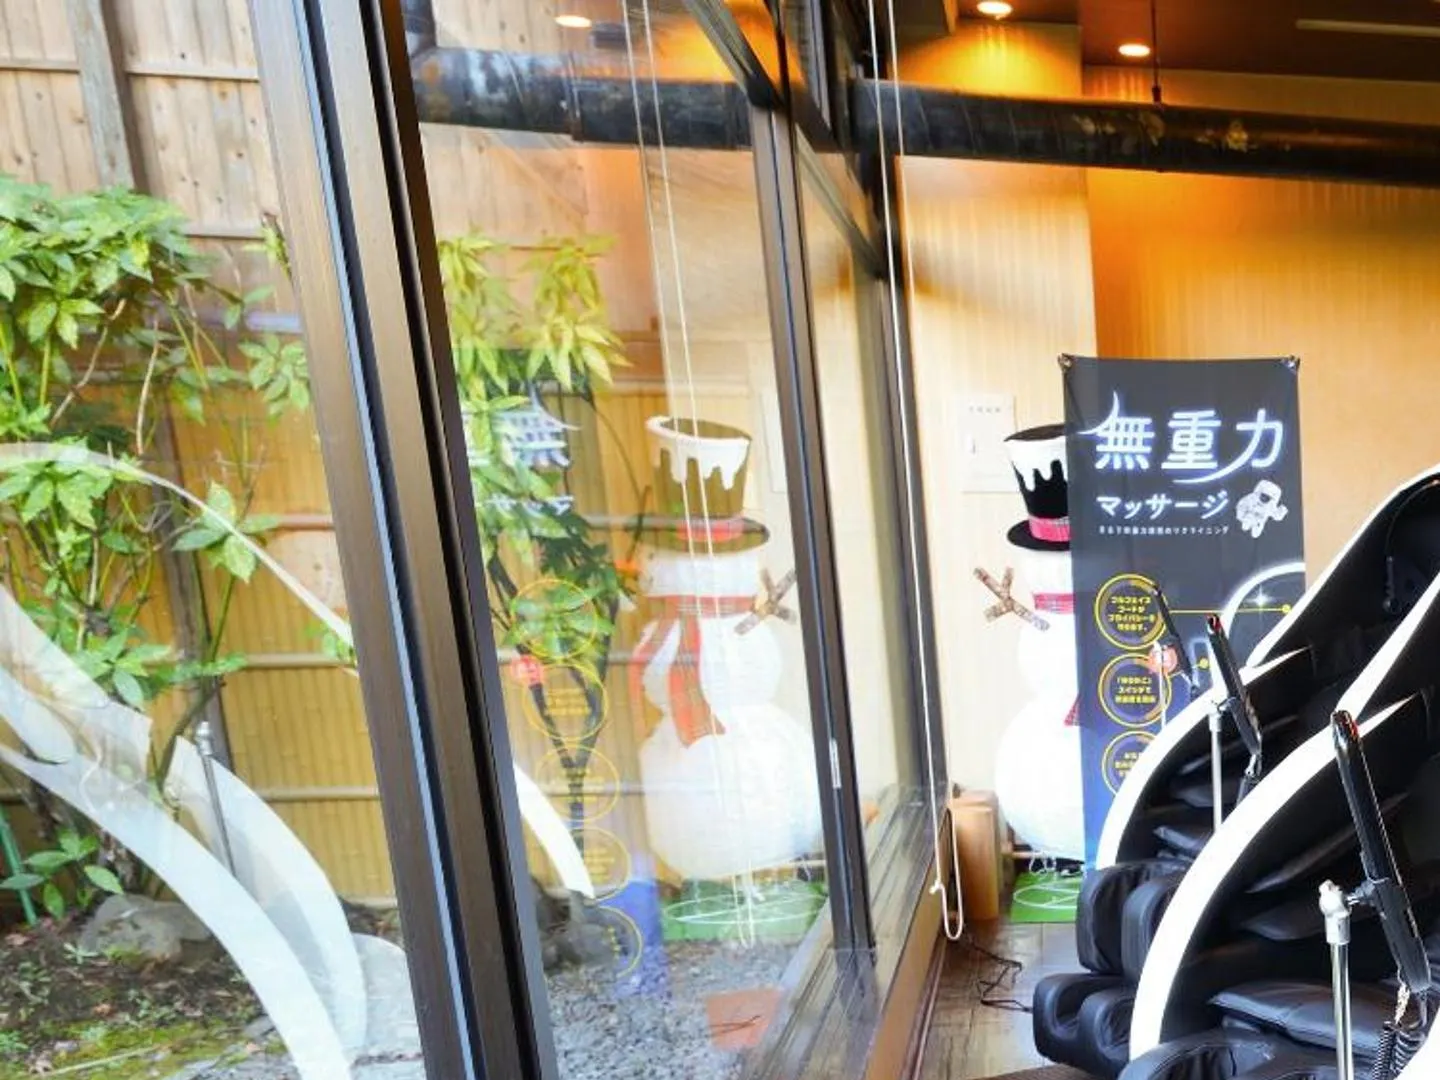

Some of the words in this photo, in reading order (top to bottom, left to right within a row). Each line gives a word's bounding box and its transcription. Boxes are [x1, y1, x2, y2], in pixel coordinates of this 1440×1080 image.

[1078, 390, 1284, 483] 無重力
[1096, 490, 1229, 520] マッサージ
